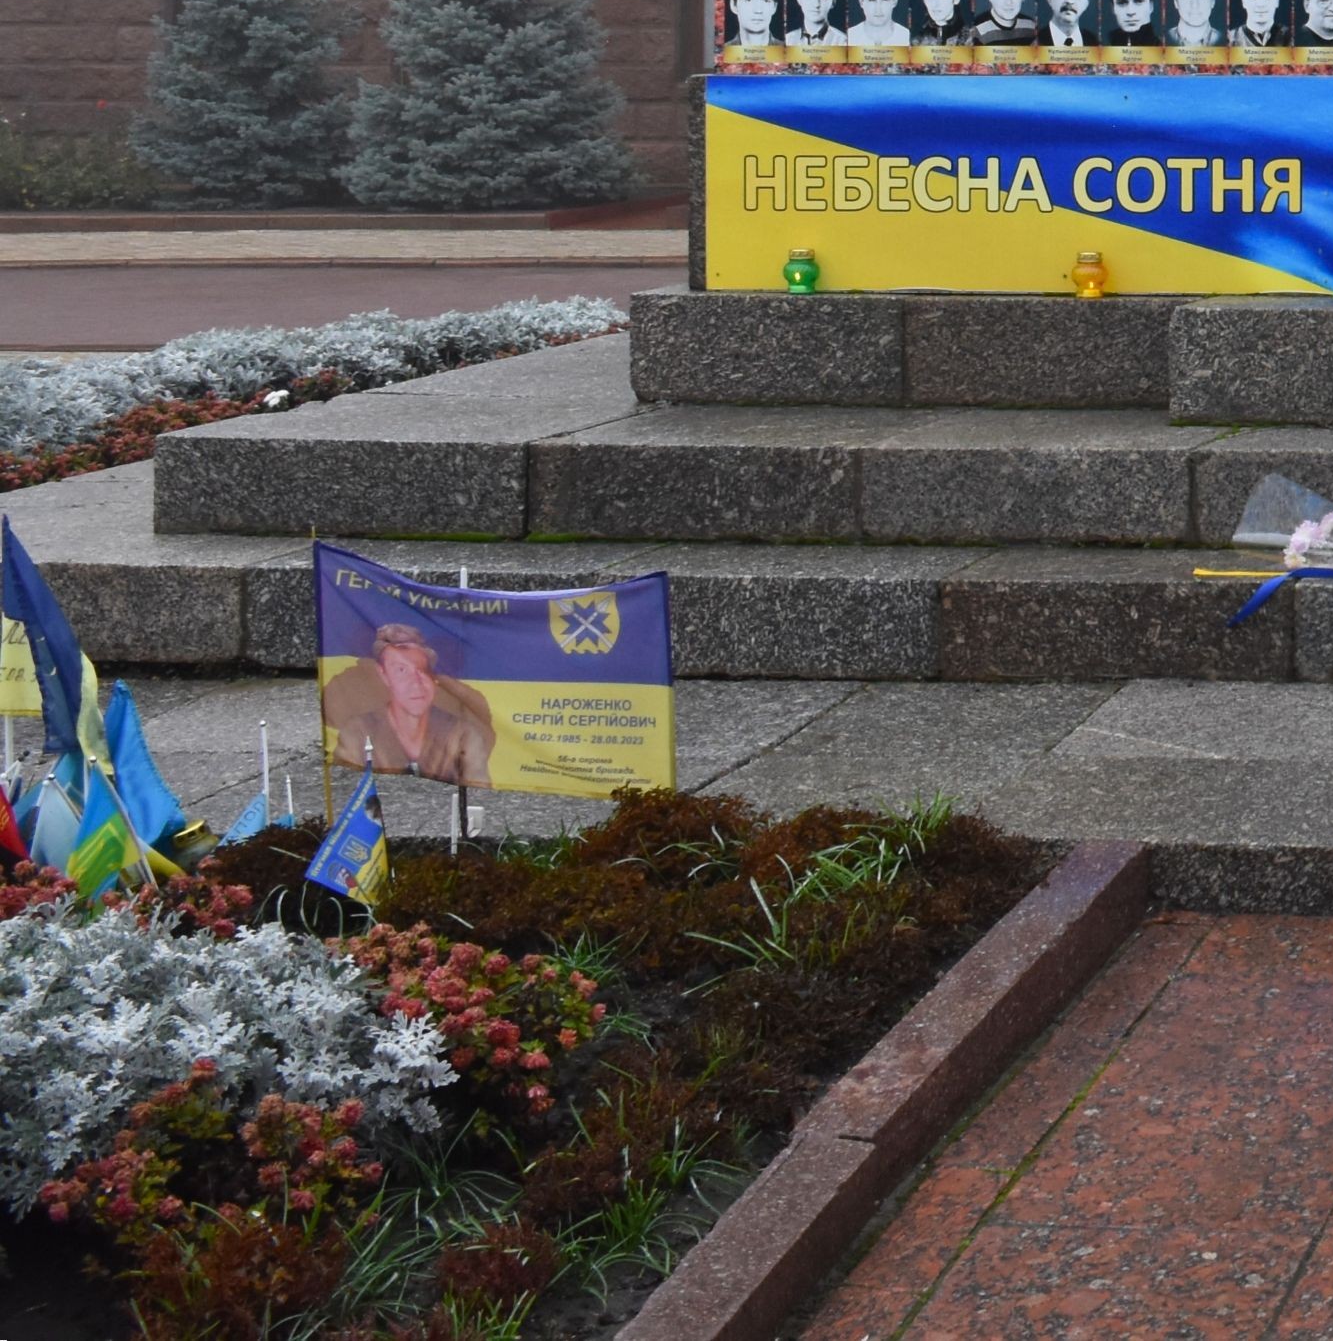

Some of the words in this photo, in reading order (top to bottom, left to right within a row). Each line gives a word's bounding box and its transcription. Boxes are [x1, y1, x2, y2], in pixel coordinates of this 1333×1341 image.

[743, 155, 1052, 213] НЕБЕСНА
[1072, 156, 1303, 214] СОТНЯ
[336, 569, 402, 598] ГЕЙ
[541, 698, 632, 711] НАРОЖЕНКО
[512, 712, 564, 726] СЕРГІЙ
[568, 712, 656, 728] СЕРГІЙОВИЧ
